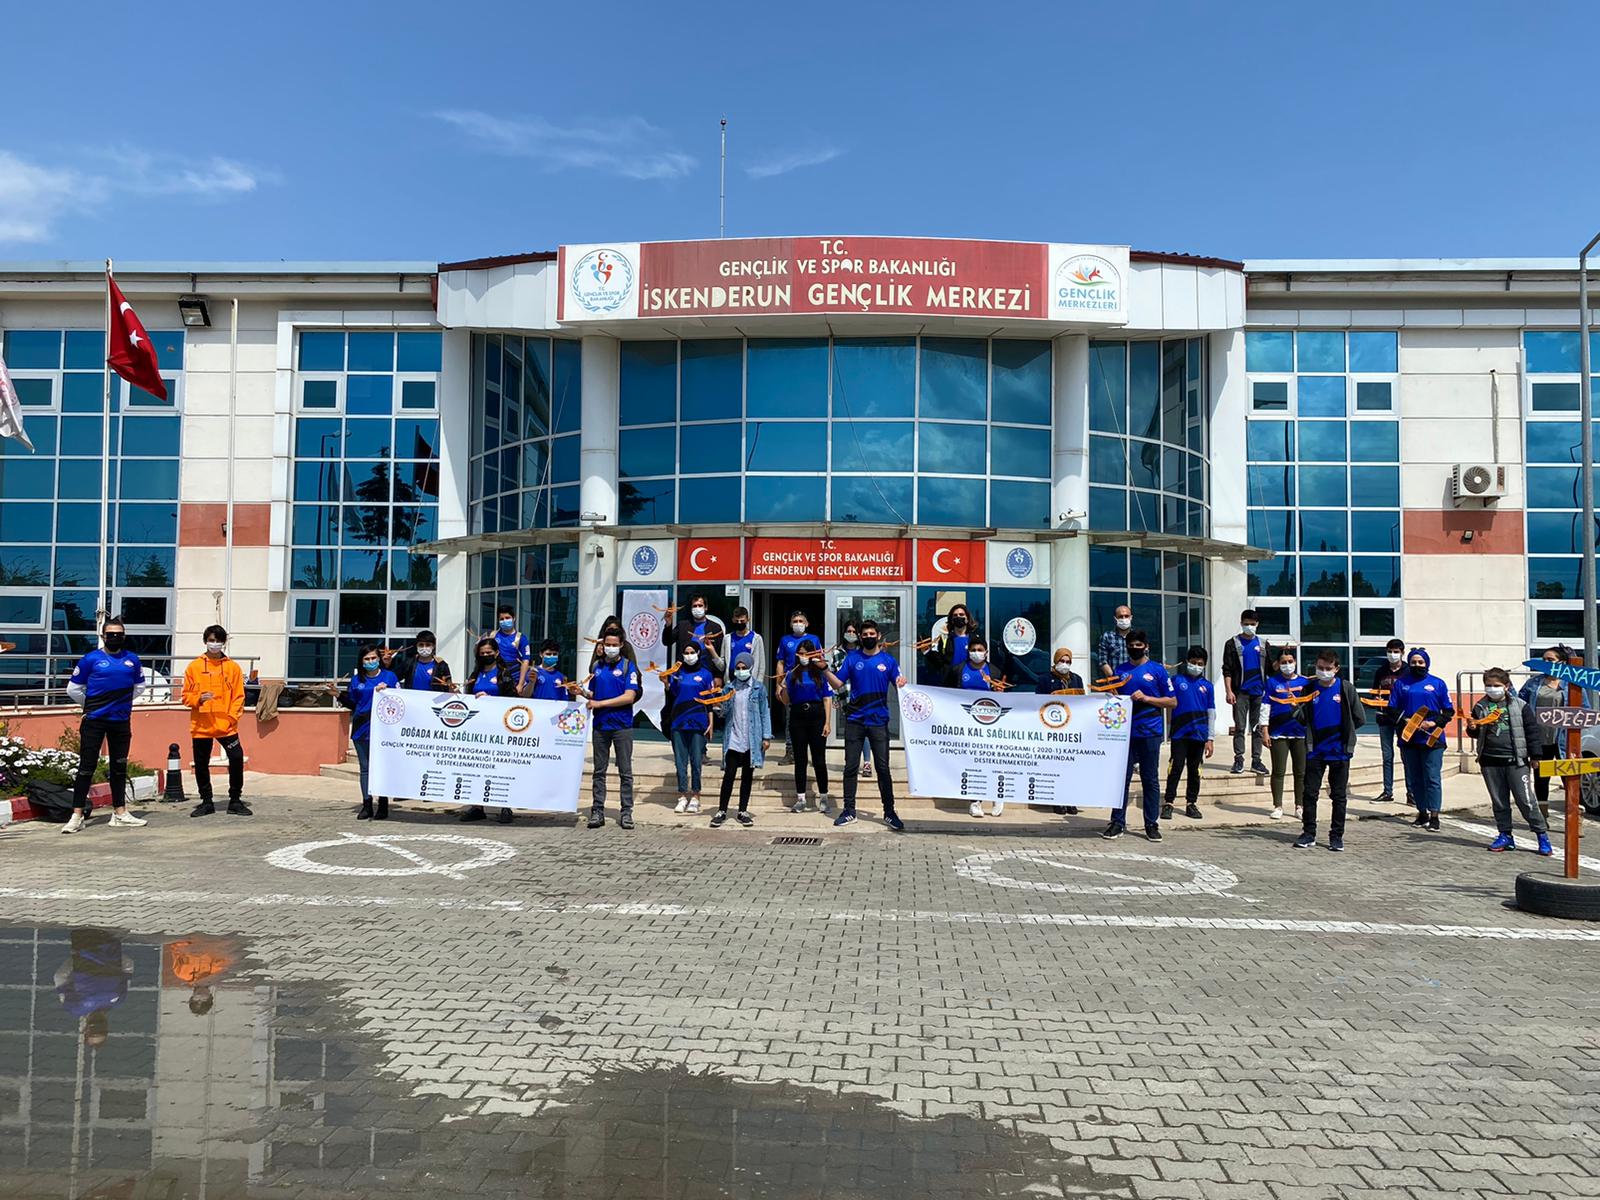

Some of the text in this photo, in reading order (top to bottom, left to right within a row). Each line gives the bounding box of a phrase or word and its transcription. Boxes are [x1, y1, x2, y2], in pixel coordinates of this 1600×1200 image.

[820, 240, 848, 255] T.C.
[719, 256, 956, 280] GENÇLİK VE SPOR BAKANLIĞI
[643, 278, 1030, 311] İSKENDERUN GENÇLİK MERKEZİ
[1059, 288, 1116, 300] GENÇLİK
[1058, 300, 1117, 309] MERKEZLERİ
[820, 540, 837, 550] T.C.
[763, 550, 894, 564] GENÇLİK VE SPOR BAKANLIĞI
[752, 562, 904, 578] İSKENDERUN GENÇLİK MERKEZİ
[401, 726, 540, 747] DOĞADA KAL SAĞLIKLI KAL PROJESİ
[931, 724, 1082, 743] DOĞADA KAL SAĞLIKLI KAL PROJESİ
[381, 740, 404, 749] GENÇLİK
[405, 743, 435, 751] PROJELERİ
[457, 747, 491, 756] PROGRAMI
[520, 752, 562, 761] KAPSAMINDA
[909, 738, 937, 746] GENÇLİK
[938, 740, 971, 748] PROJELERİ
[972, 742, 993, 750] DESTEK
[1063, 748, 1106, 756] KAPSAMINDA
[939, 748, 967, 756] GENÇLİK
[997, 751, 1032, 759] BAKANLIĞI
[1034, 753, 1075, 761] TARAFINDAN
[458, 754, 492, 762] BAKANLIĞI
[493, 756, 531, 765] TARAFINDAN
[1554, 760, 1588, 776] KAT
